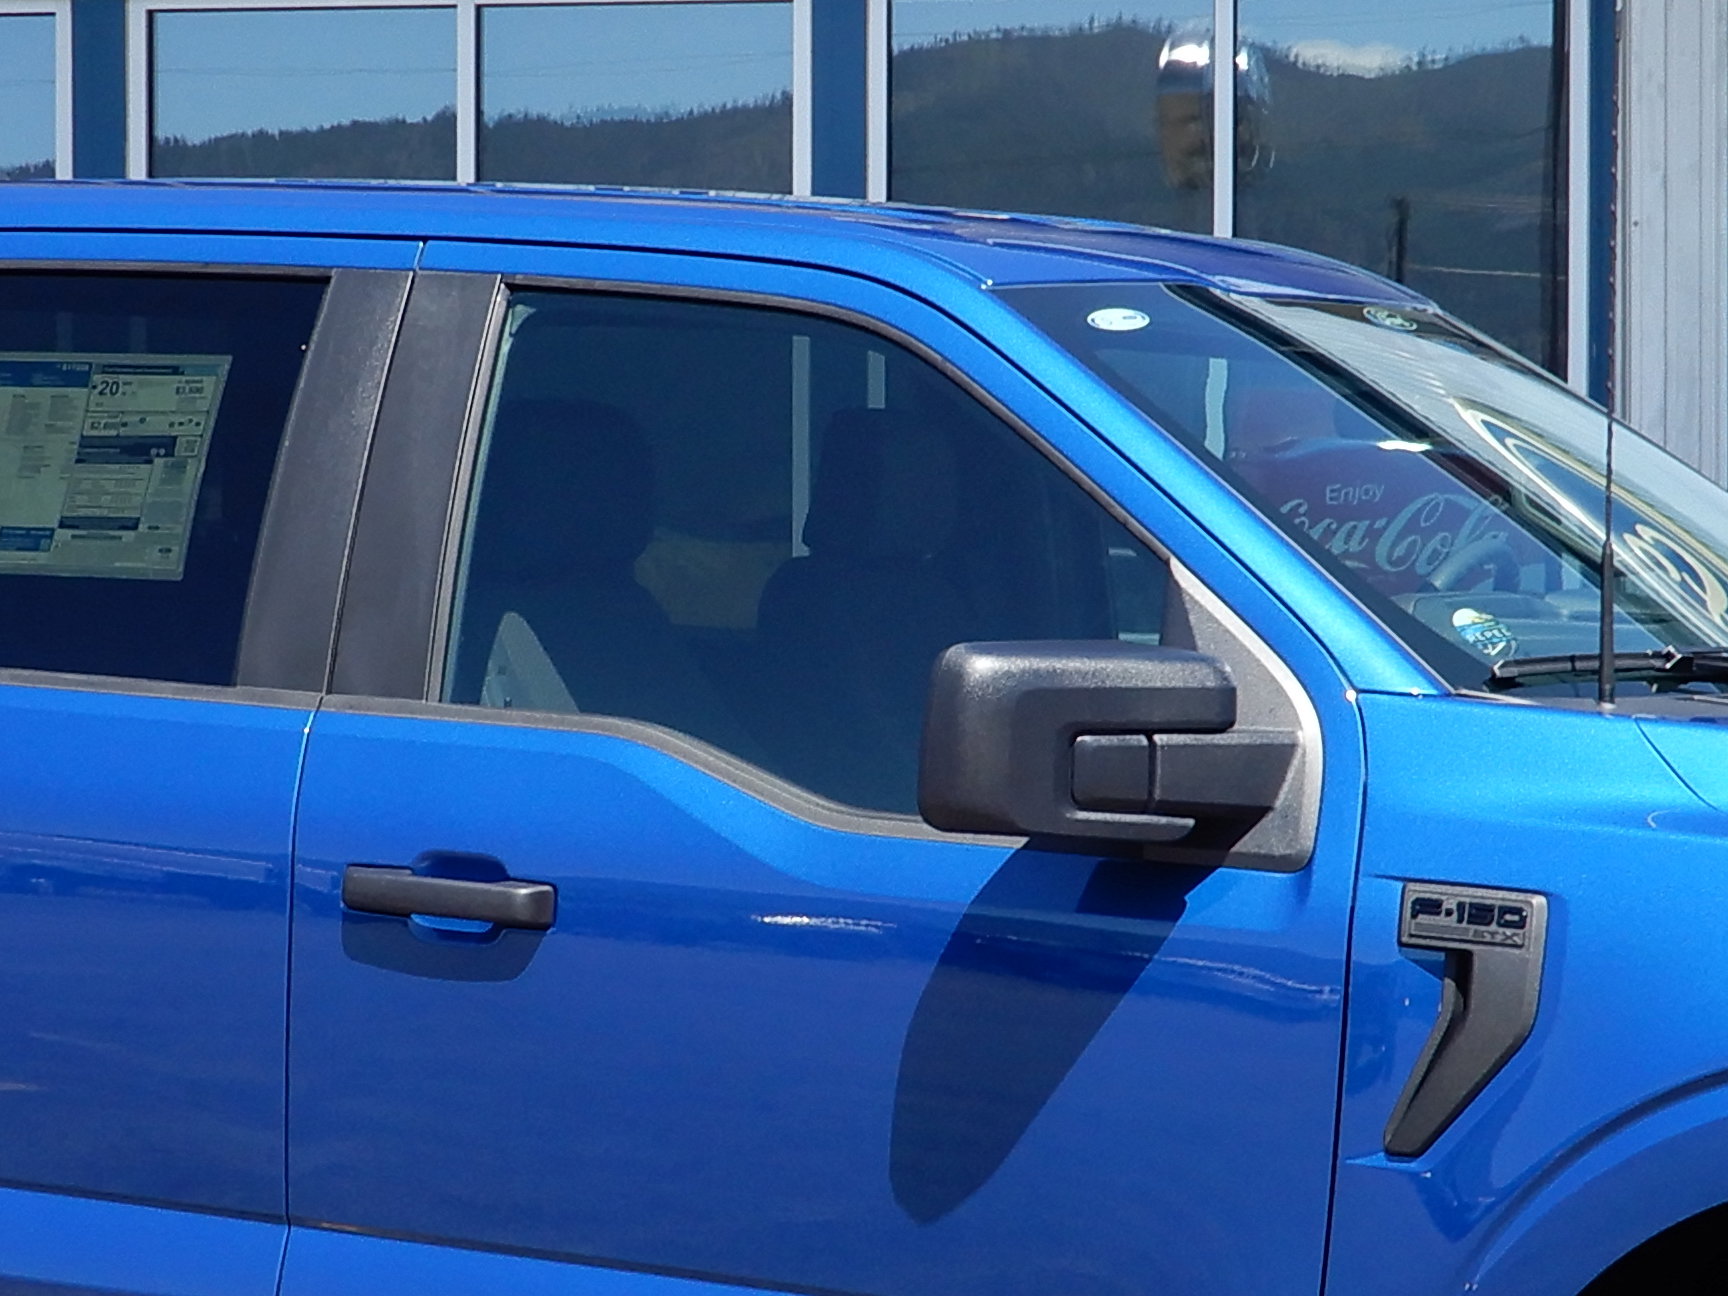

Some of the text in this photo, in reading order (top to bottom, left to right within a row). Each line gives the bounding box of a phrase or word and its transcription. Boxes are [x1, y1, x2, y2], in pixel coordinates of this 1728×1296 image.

[1325, 483, 1385, 505] Enjoy
[1279, 492, 1509, 576] ca-Col
[1410, 897, 1529, 930] F-150
